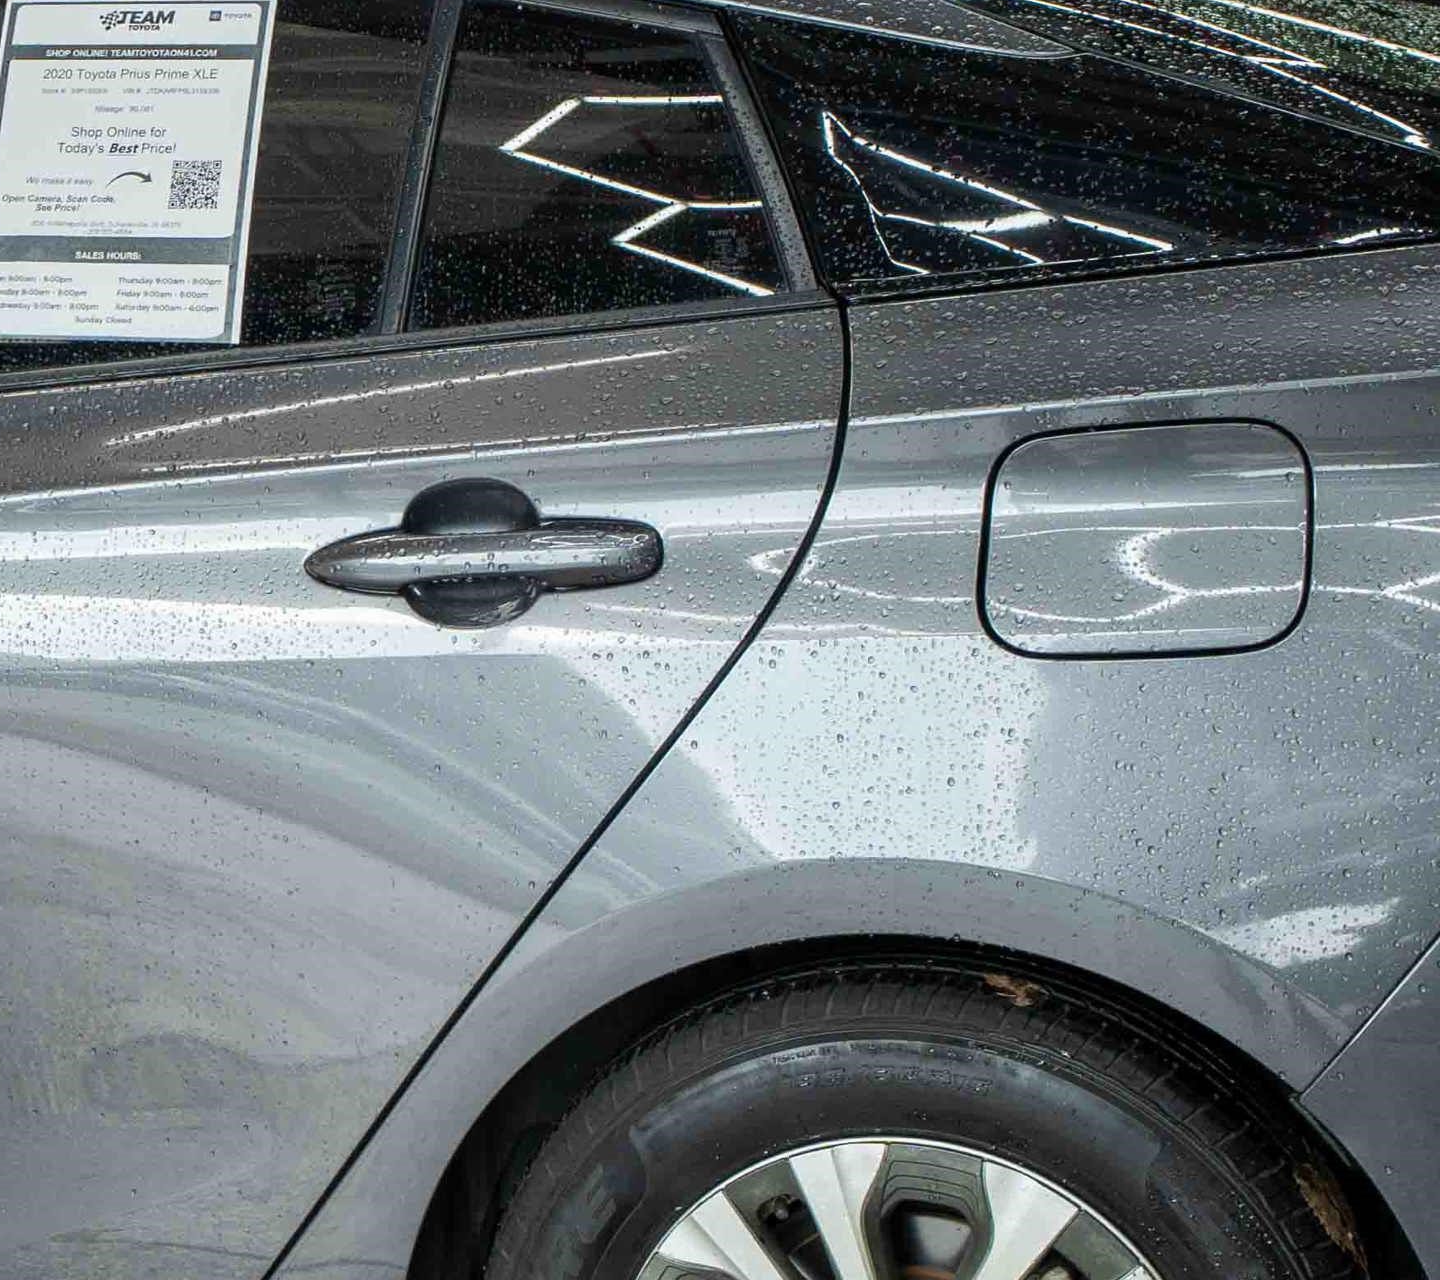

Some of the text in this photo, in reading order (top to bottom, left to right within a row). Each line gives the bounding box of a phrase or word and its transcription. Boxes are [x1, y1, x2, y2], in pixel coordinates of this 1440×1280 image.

[116, 10, 176, 24] TEAM
[128, 24, 161, 32] TOYOTA
[45, 49, 72, 57] SHOP
[73, 49, 108, 57] ONLINE!
[42, 68, 219, 82] 2020 Toyota Prius Prime XLE
[70, 126, 167, 141] Shop Online for
[56, 142, 177, 157] Today's Best Price!
[1, 194, 25, 204] Open
[66, 195, 88, 204] Scan
[34, 204, 80, 212] See Price!
[75, 251, 142, 260] SALES HOURS:
[116, 290, 140, 298] Friday
[105, 316, 132, 324] Closed
